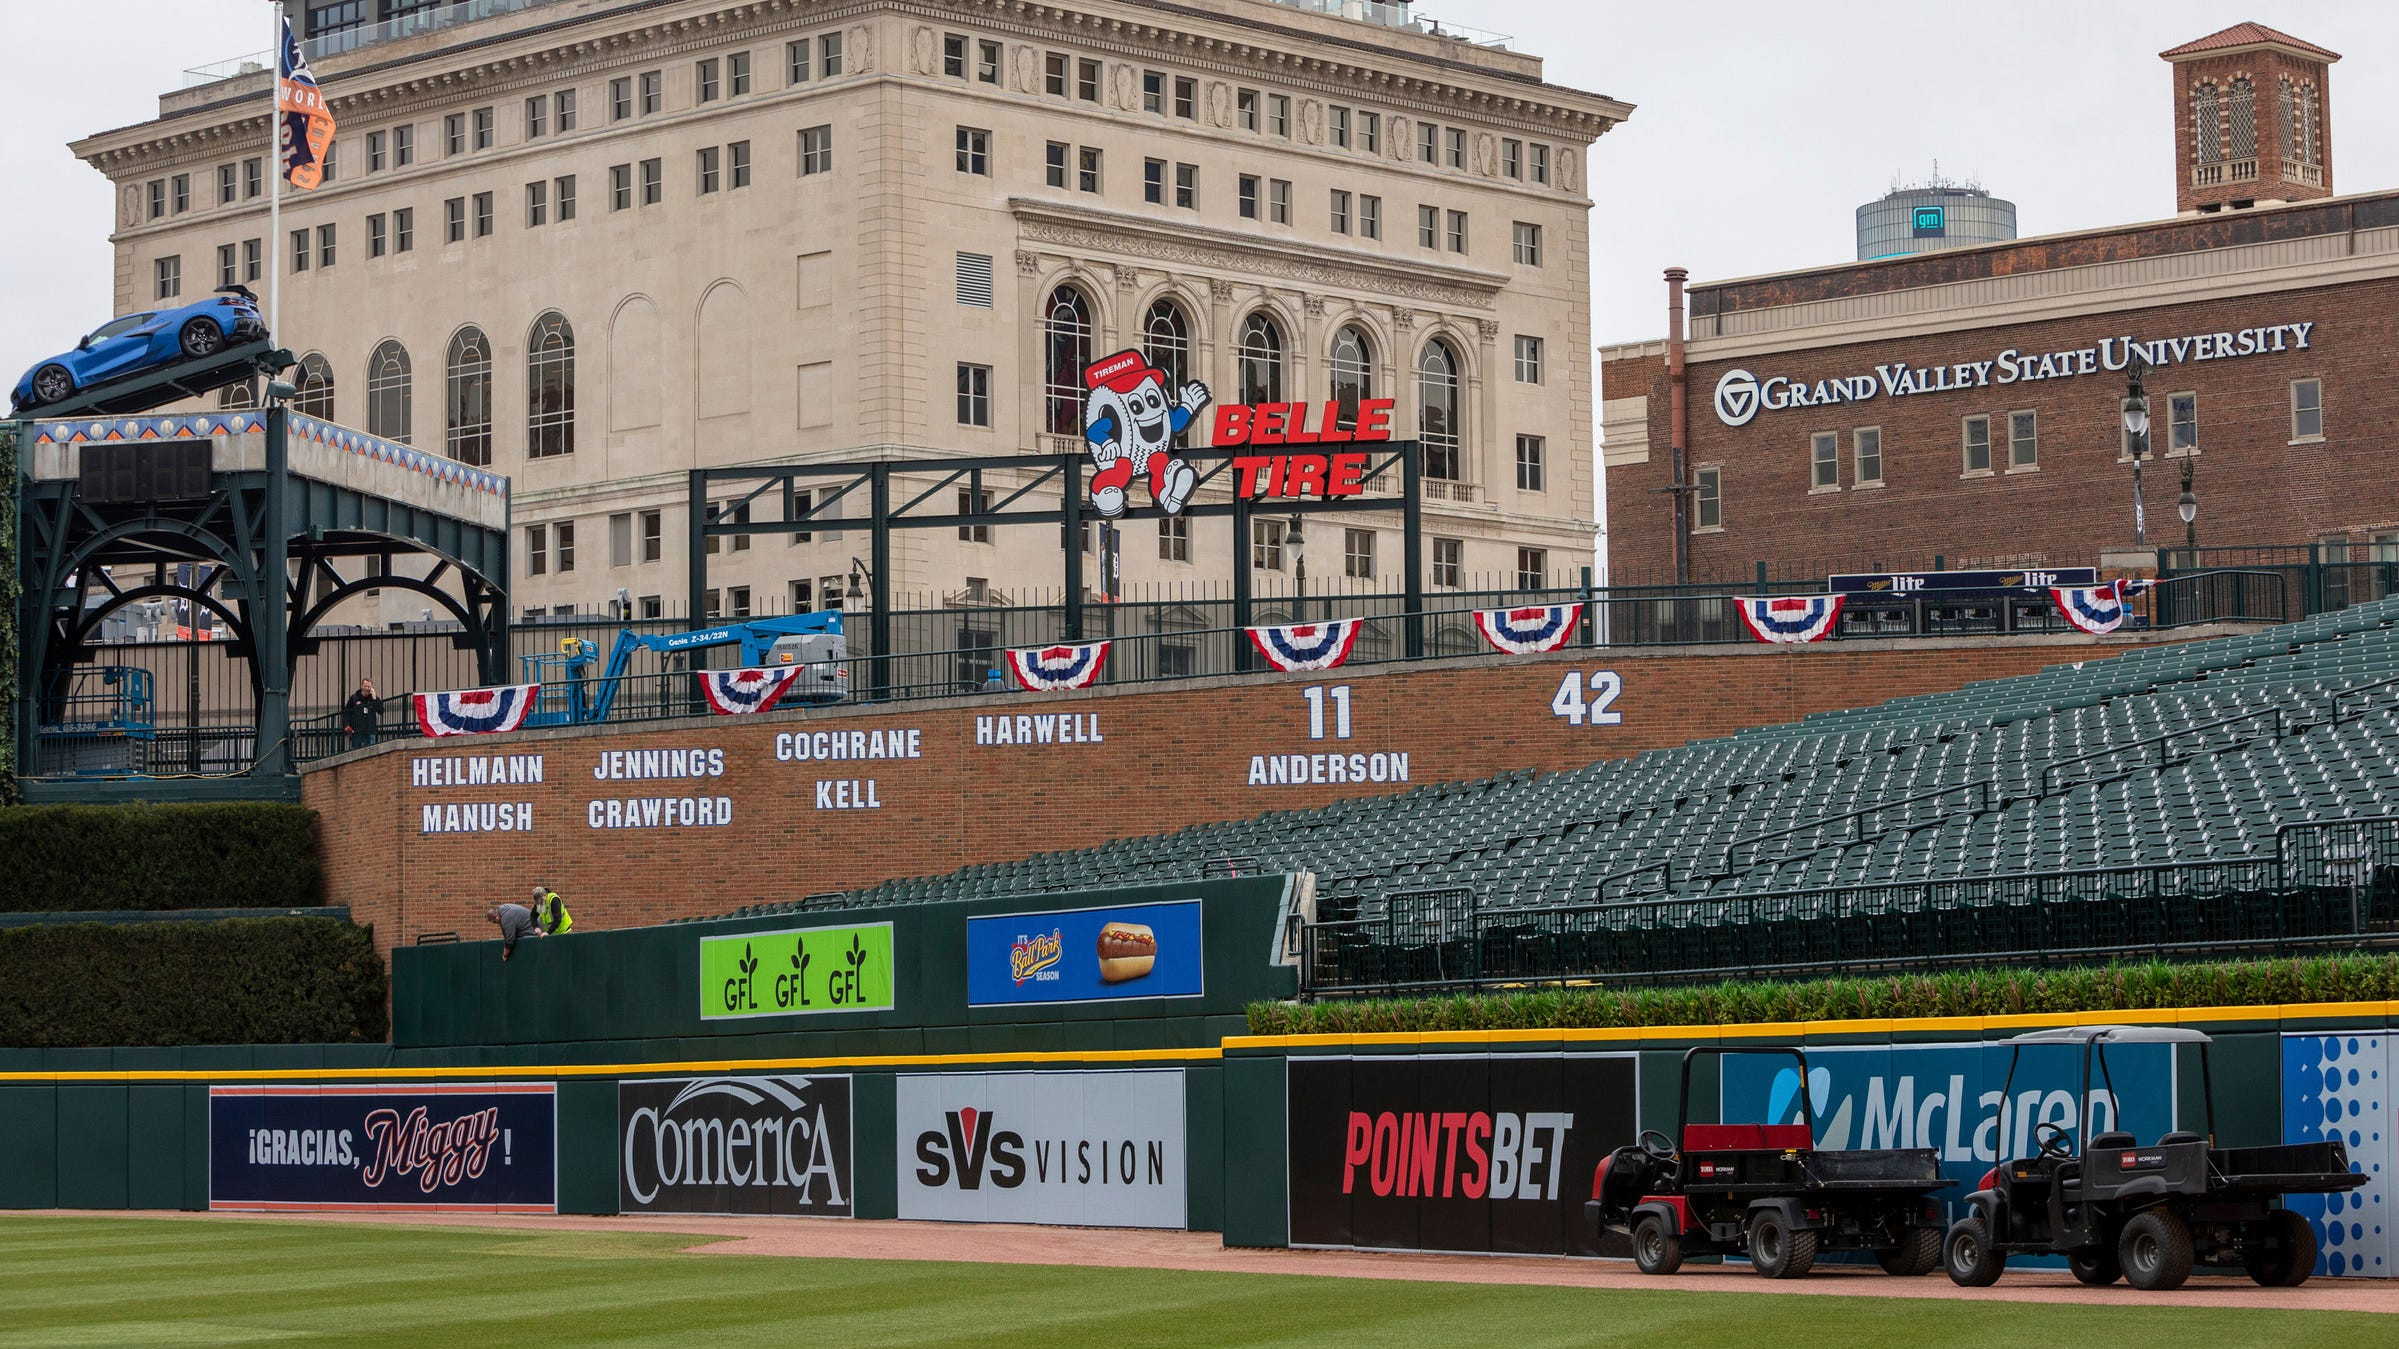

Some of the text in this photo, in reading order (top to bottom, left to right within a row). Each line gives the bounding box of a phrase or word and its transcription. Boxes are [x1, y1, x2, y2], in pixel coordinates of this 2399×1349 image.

[281, 86, 330, 114] WORL
[1919, 213, 1938, 229] gm
[1093, 356, 1134, 380] TIREMAN
[1760, 321, 2313, 410] GRAND VALLEY STATE UNIVERSITY
[1211, 398, 1396, 447] BELLE
[1233, 452, 1367, 499] TIRE
[668, 631, 729, 647] Genie Z-34/22N
[1302, 684, 1352, 740] 11
[1550, 670, 1623, 726] 42
[775, 728, 923, 762] COCHRANE
[976, 713, 1104, 745] HARWELL
[411, 754, 544, 787] HEILMANN
[593, 748, 725, 780] JENNINGS
[1247, 751, 1410, 786] ANDERSON
[815, 779, 881, 810] KELL
[421, 802, 533, 833] MANUSH
[588, 796, 733, 829] CRAWFORD
[724, 949, 867, 1011] GFL GFL GFL
[1035, 970, 1060, 981] SEASON
[1860, 1074, 2120, 1163] McLaren
[1035, 1139, 1163, 1185] VISION
[1342, 1110, 1574, 1200] POINTSBET
